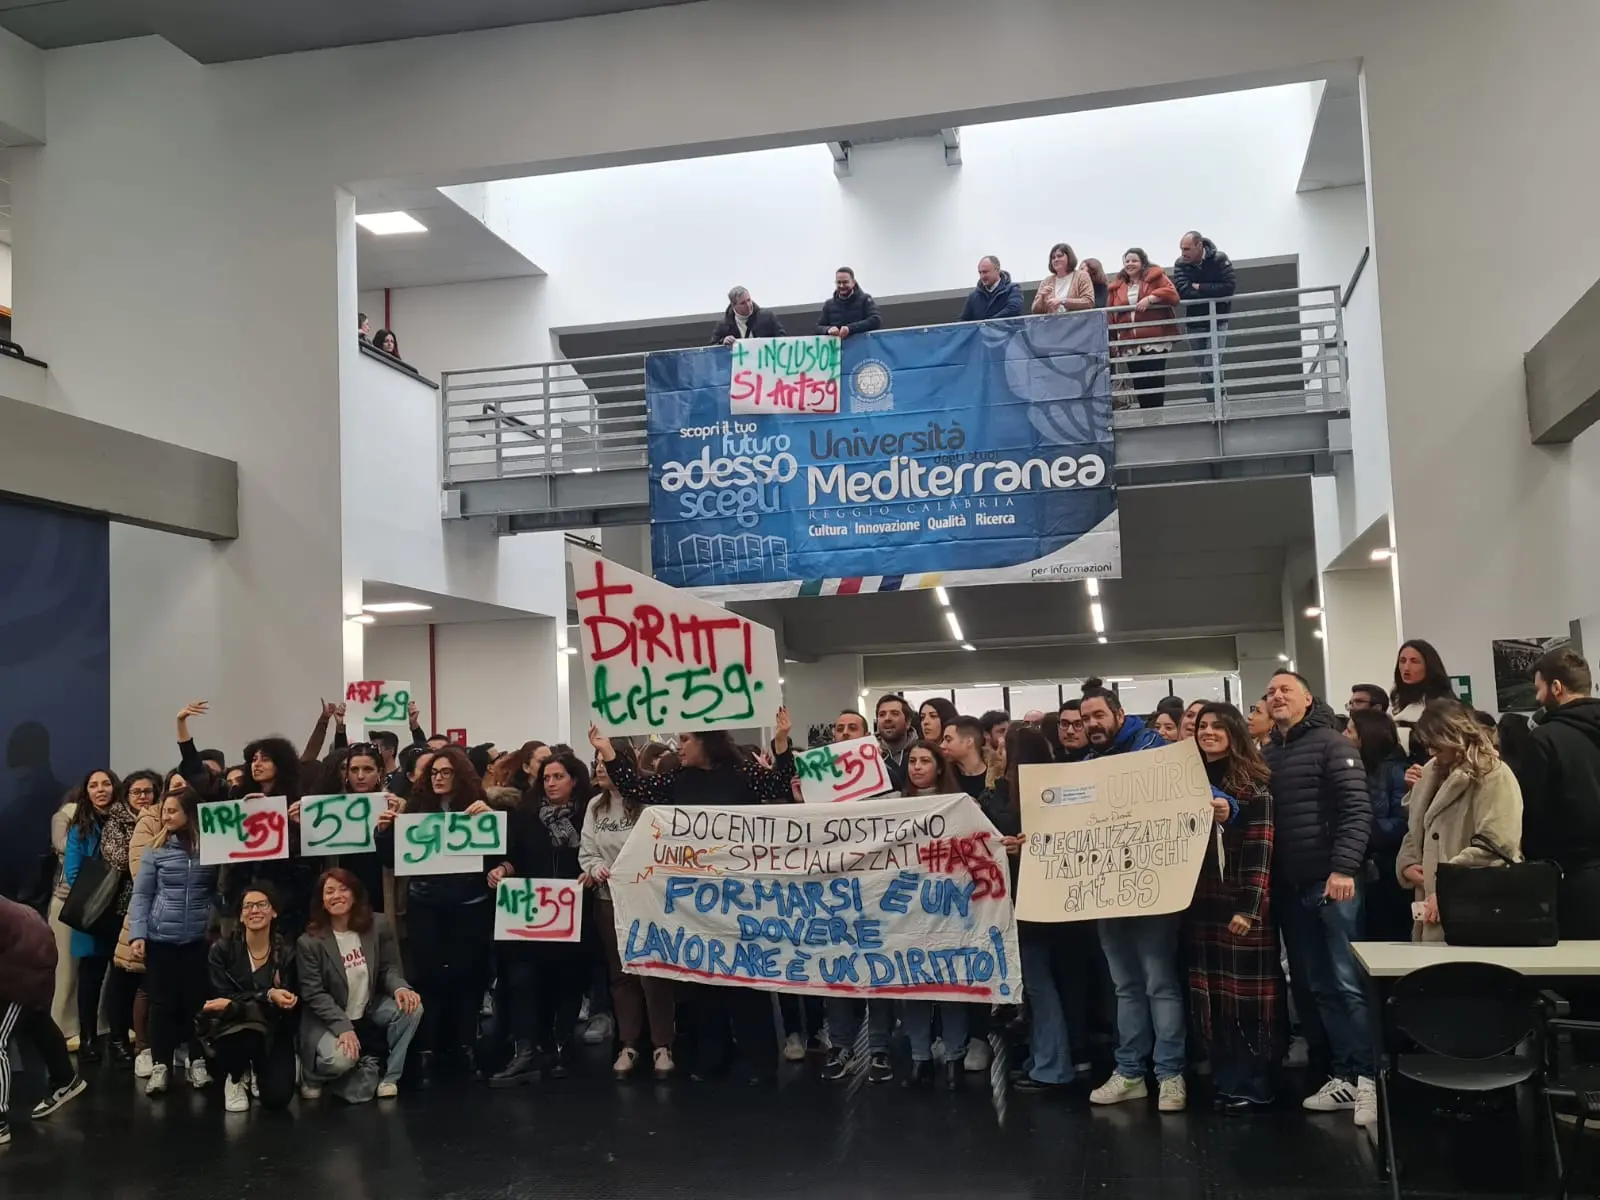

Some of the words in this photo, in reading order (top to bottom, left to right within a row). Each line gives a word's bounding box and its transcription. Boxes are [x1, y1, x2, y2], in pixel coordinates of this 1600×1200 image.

[730, 370, 763, 406] SI
[680, 421, 720, 441] scopri
[722, 420, 730, 436] il
[734, 420, 758, 434] tuo
[722, 431, 791, 457] futuro
[809, 419, 966, 460] Università
[660, 444, 798, 492] adesso
[807, 452, 1106, 506] Mediterranea
[808, 506, 890, 520] REGGIO
[906, 498, 1014, 514] CALABRIA
[808, 524, 848, 537] Cultura
[855, 519, 920, 534] Innovazione
[927, 514, 967, 529] Qualità
[975, 512, 1016, 526] Ricerca
[1031, 568, 1049, 578] per
[1050, 562, 1112, 574] informazioni
[346, 680, 385, 703] ART
[364, 690, 409, 722] 59
[832, 743, 884, 803] 59
[304, 796, 371, 848] 59
[447, 813, 501, 851] 59
[671, 807, 777, 844] DOCENTI
[786, 820, 811, 844] DI
[823, 814, 946, 845] SOSTEGNO
[1029, 818, 1172, 857] SPECIALIZZATI
[1176, 807, 1213, 840] NON
[653, 843, 708, 869] UNIRC
[724, 842, 922, 876] SPECIALIZZATI
[1039, 839, 1189, 880] TAPPABUCHI
[664, 875, 863, 919] FORMARSI
[920, 877, 977, 918] UN
[737, 914, 883, 949] DOVERE
[624, 918, 782, 978] LAVORARE
[819, 952, 860, 984] UN
